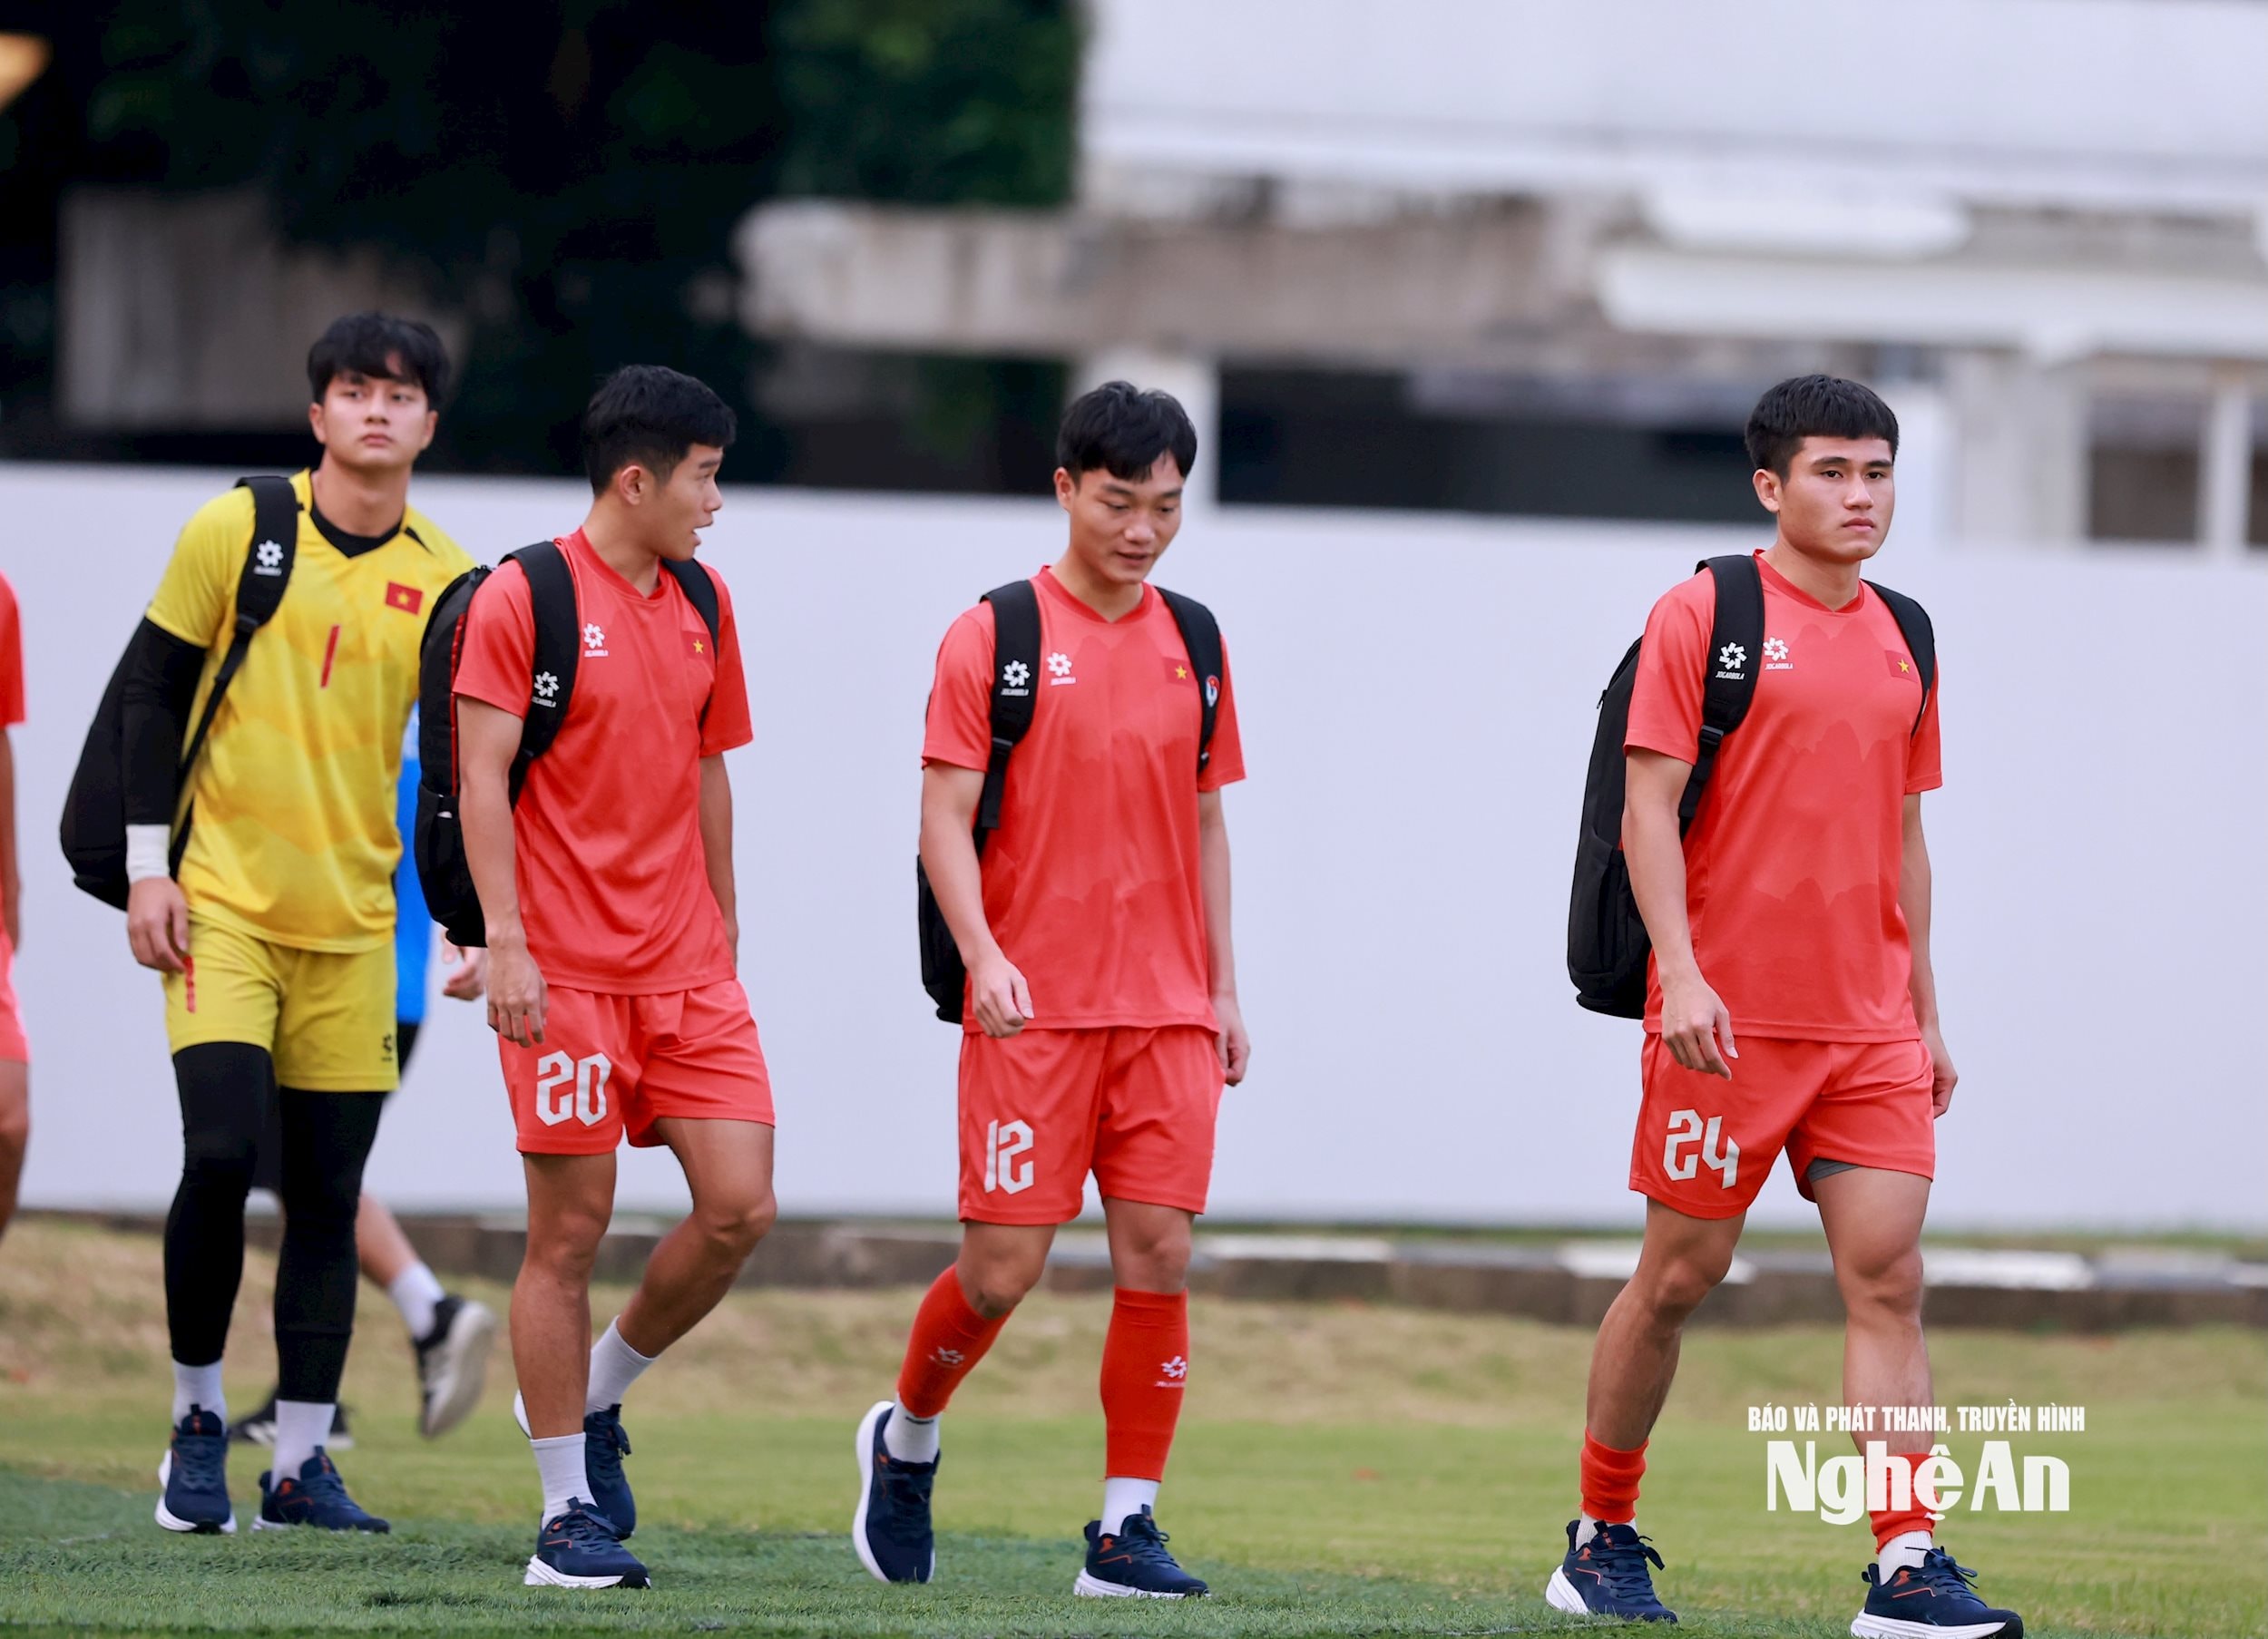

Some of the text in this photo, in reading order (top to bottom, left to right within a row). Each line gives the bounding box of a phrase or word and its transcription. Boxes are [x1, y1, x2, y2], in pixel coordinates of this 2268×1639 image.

[536, 1049, 612, 1127] 20
[984, 1118, 1034, 1195] 12
[1663, 1108, 1741, 1190] 24
